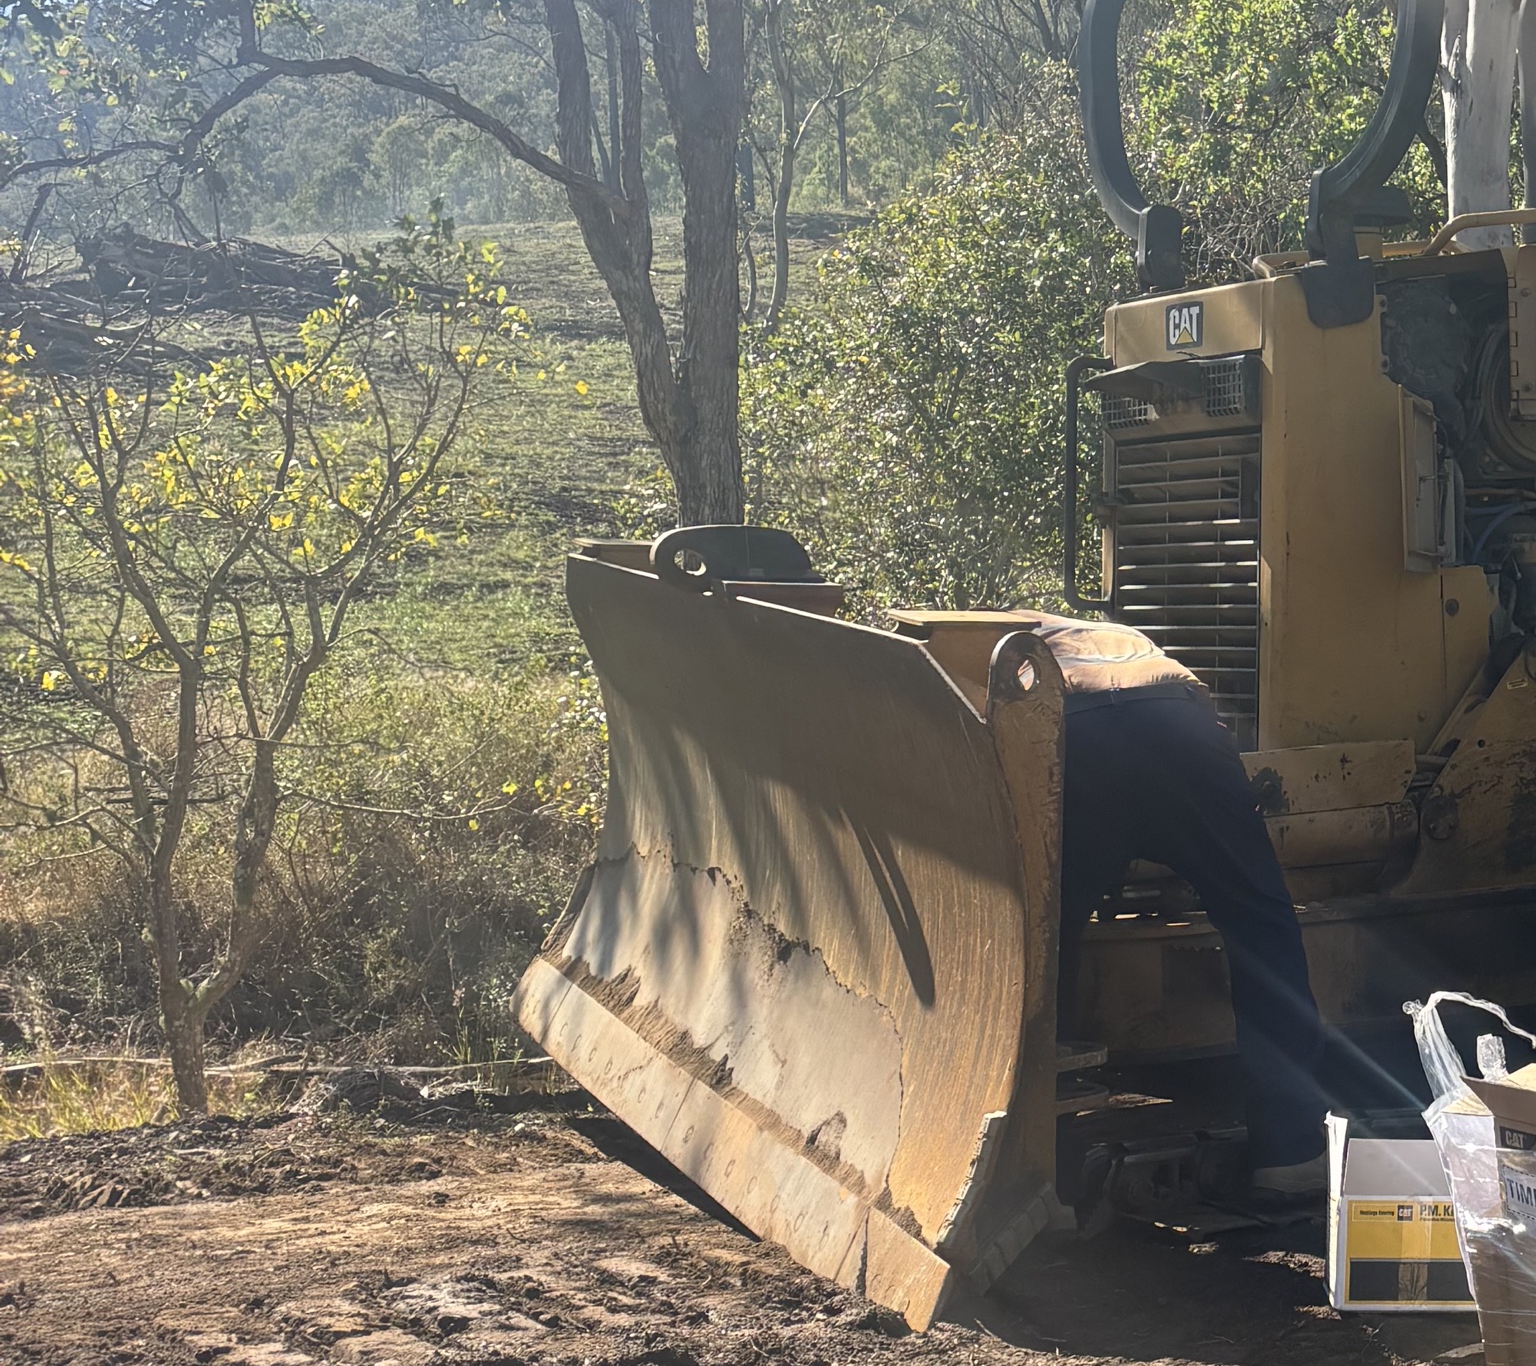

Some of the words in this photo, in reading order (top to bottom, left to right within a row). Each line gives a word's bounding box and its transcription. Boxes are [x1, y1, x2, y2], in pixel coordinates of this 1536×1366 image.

[1169, 306, 1200, 345] CAT
[1505, 1130, 1524, 1149] CAT
[1398, 1208, 1413, 1217] CAT
